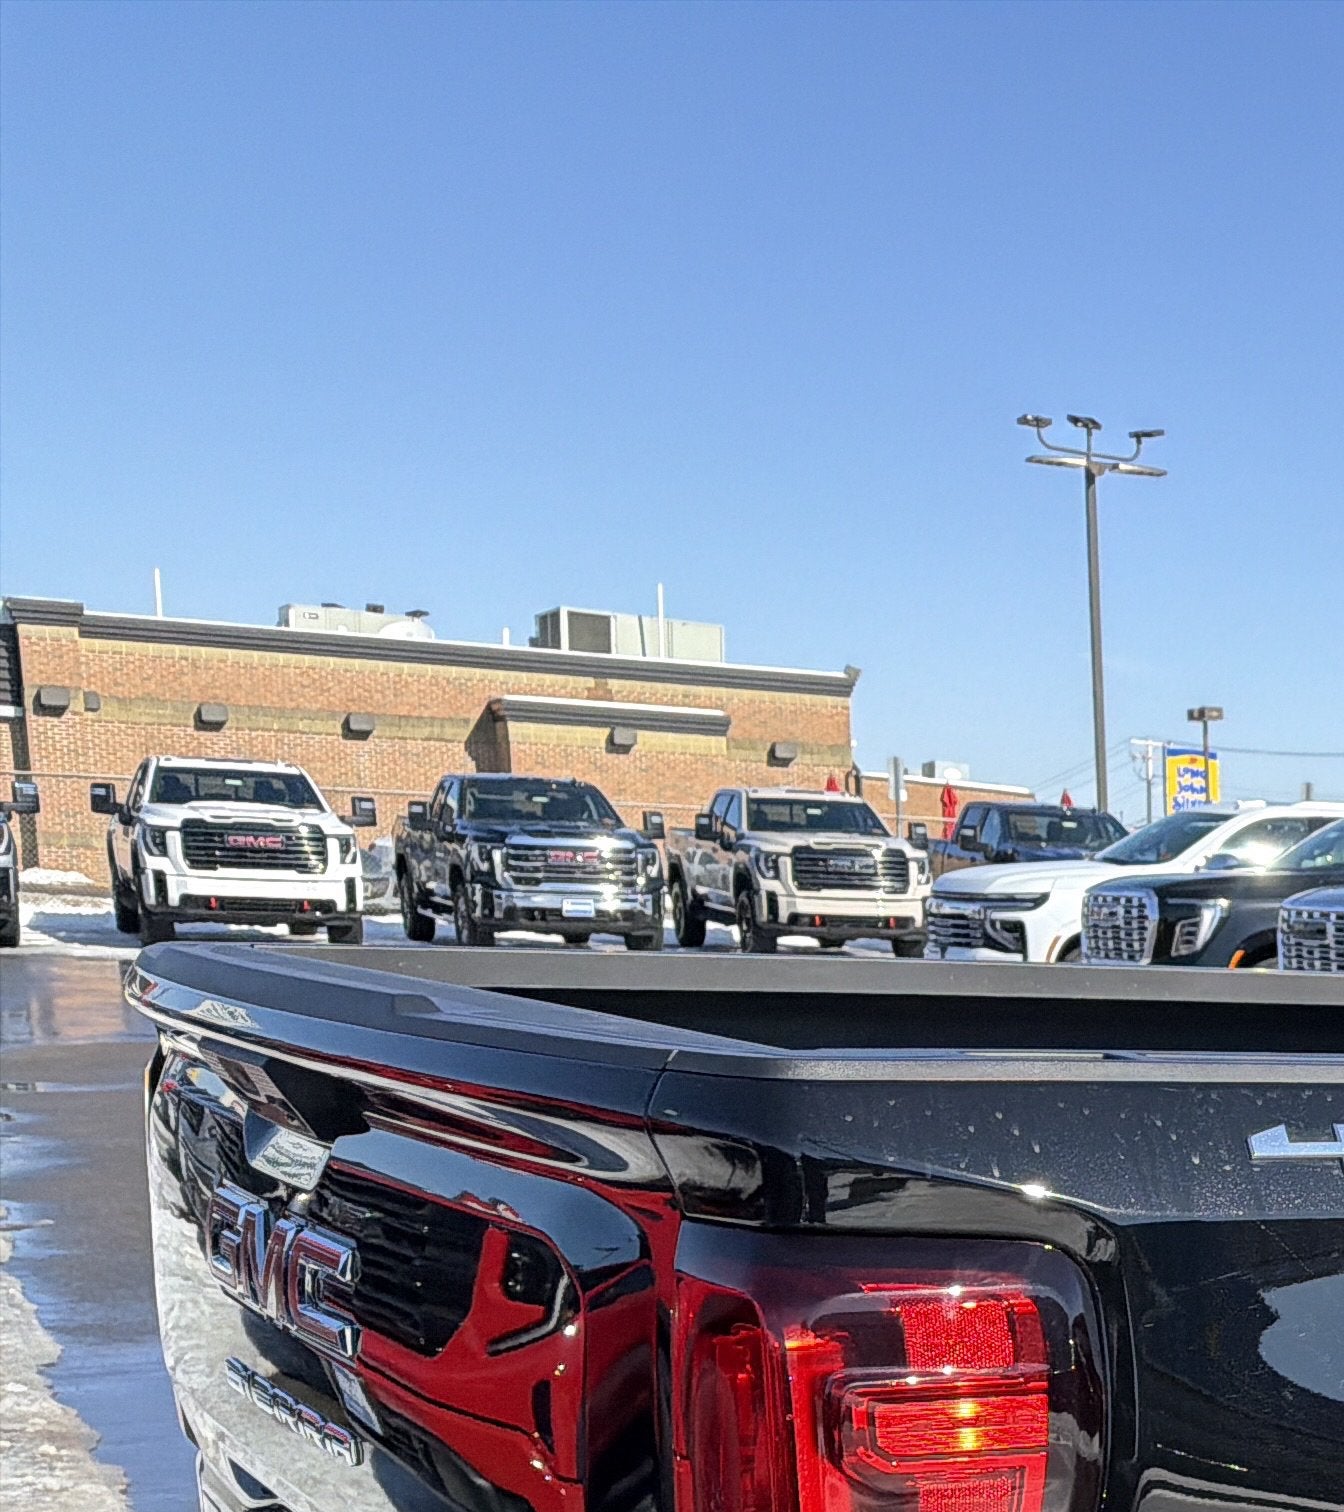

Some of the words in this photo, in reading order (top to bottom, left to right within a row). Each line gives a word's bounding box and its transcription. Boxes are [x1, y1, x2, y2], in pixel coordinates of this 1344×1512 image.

[227, 835, 283, 848] GMC
[207, 1184, 363, 1358] GMC
[225, 1355, 364, 1466] SIERRA
